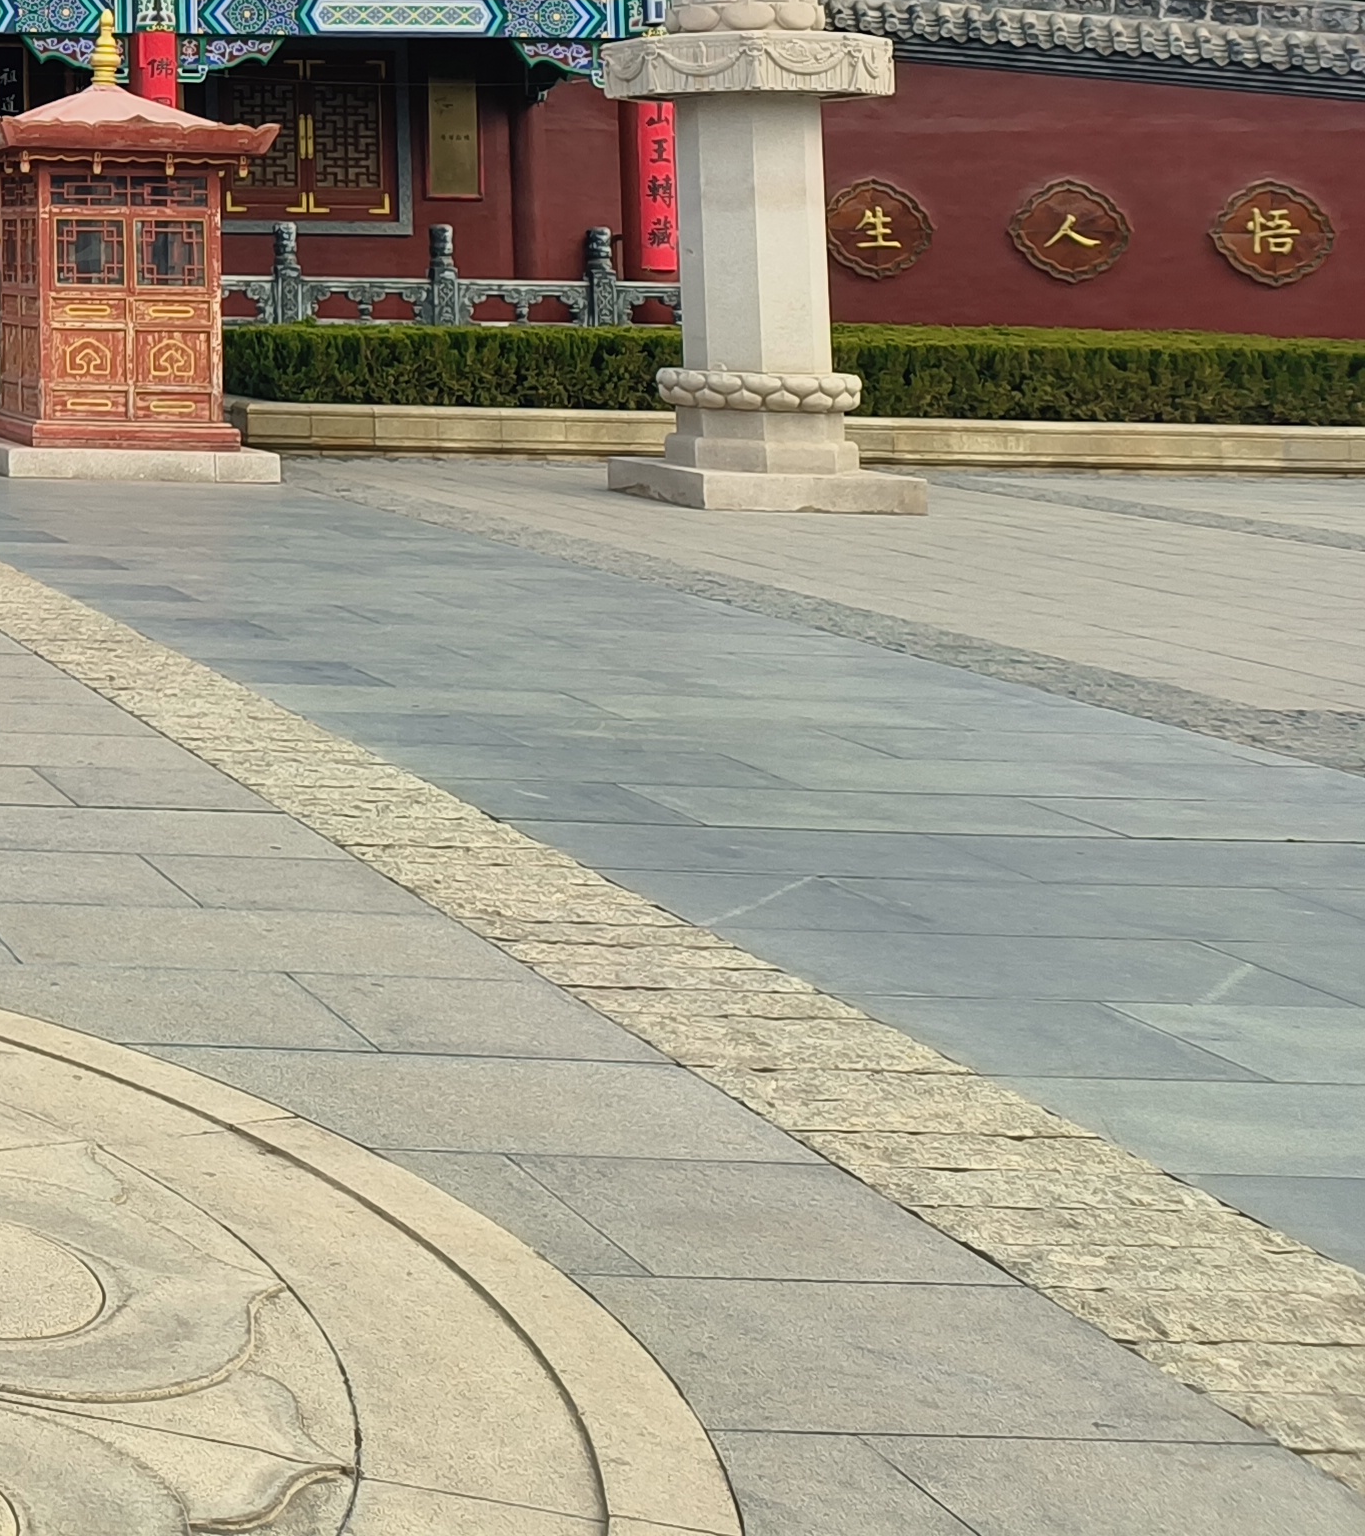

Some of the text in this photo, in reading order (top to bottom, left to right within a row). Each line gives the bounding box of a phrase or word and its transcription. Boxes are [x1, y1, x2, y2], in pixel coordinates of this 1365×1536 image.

[645, 102, 675, 250] 山王轉藏
[855, 205, 1302, 255] 悟 人 生
